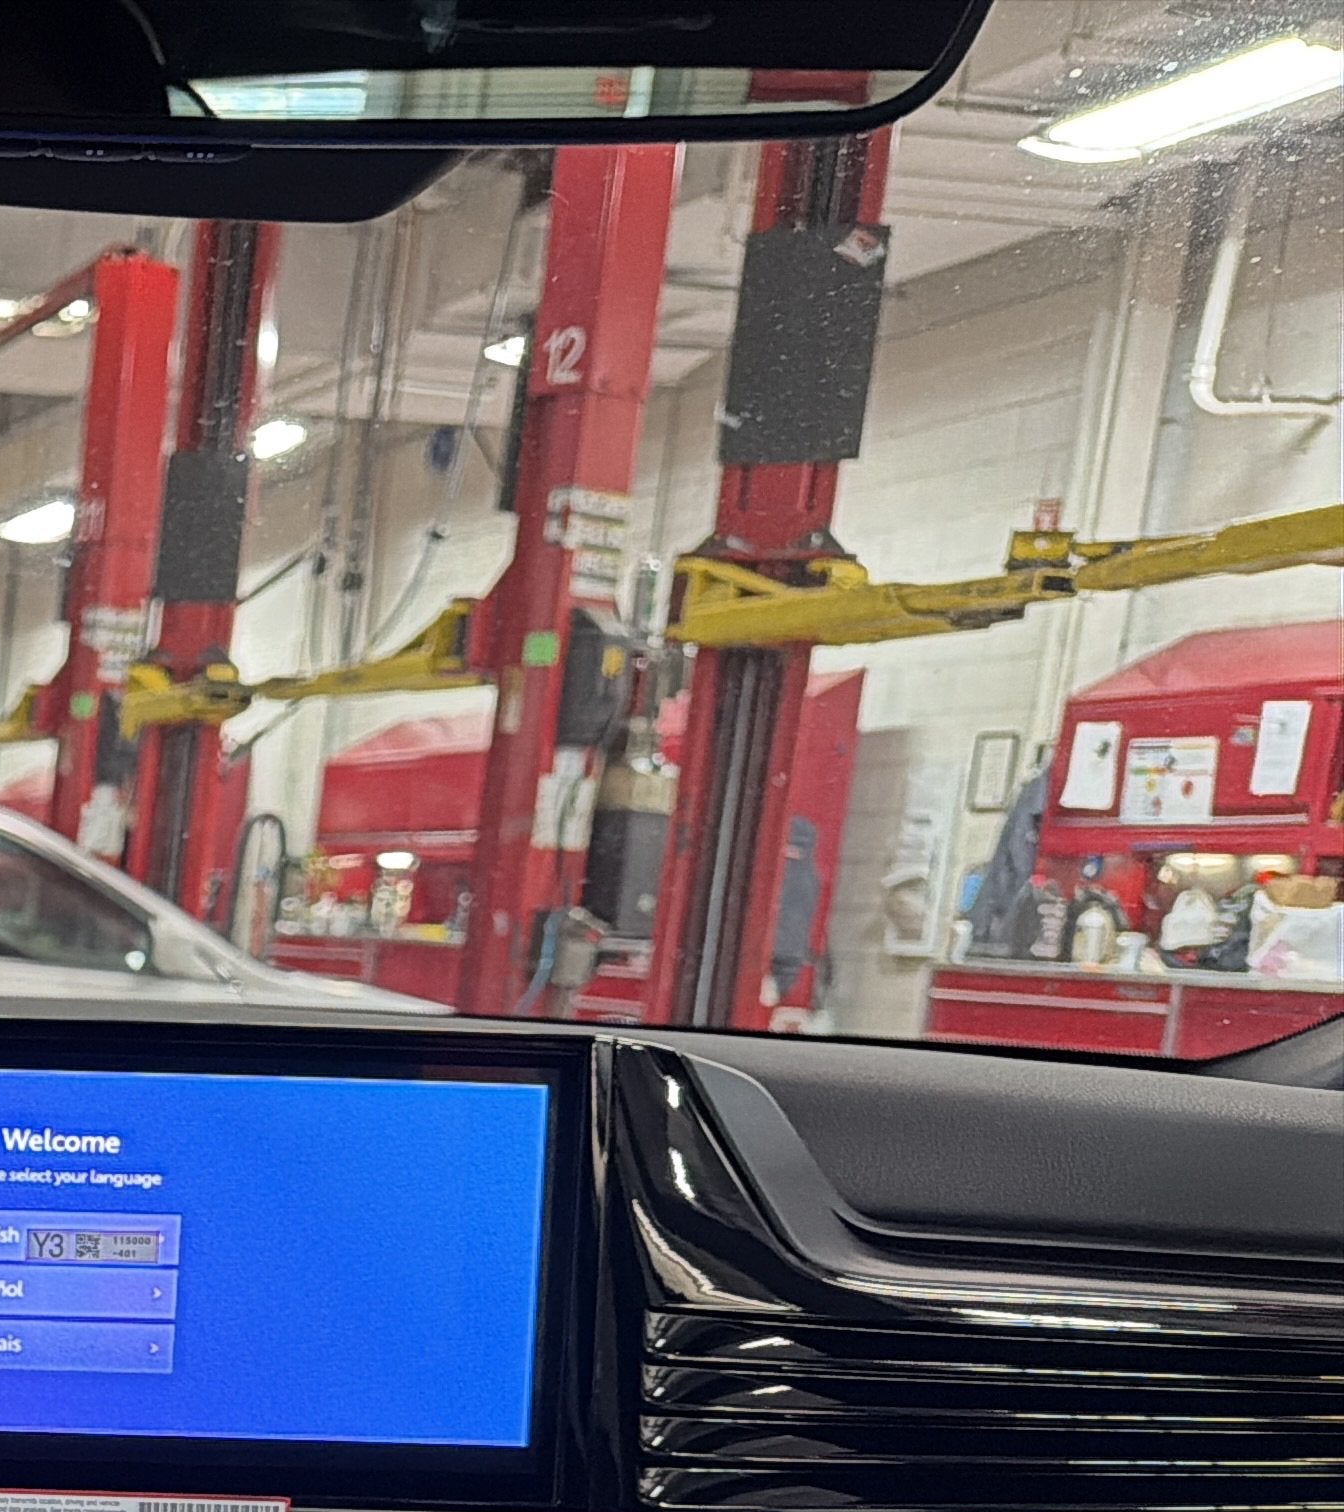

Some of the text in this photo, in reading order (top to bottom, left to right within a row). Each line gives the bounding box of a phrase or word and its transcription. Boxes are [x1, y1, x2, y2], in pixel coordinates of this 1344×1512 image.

[543, 325, 587, 385] 12
[1, 1127, 121, 1154] Welcome
[8, 1168, 51, 1184] select
[53, 1171, 87, 1186] your
[89, 1169, 161, 1189] language
[33, 1232, 64, 1258] Y3
